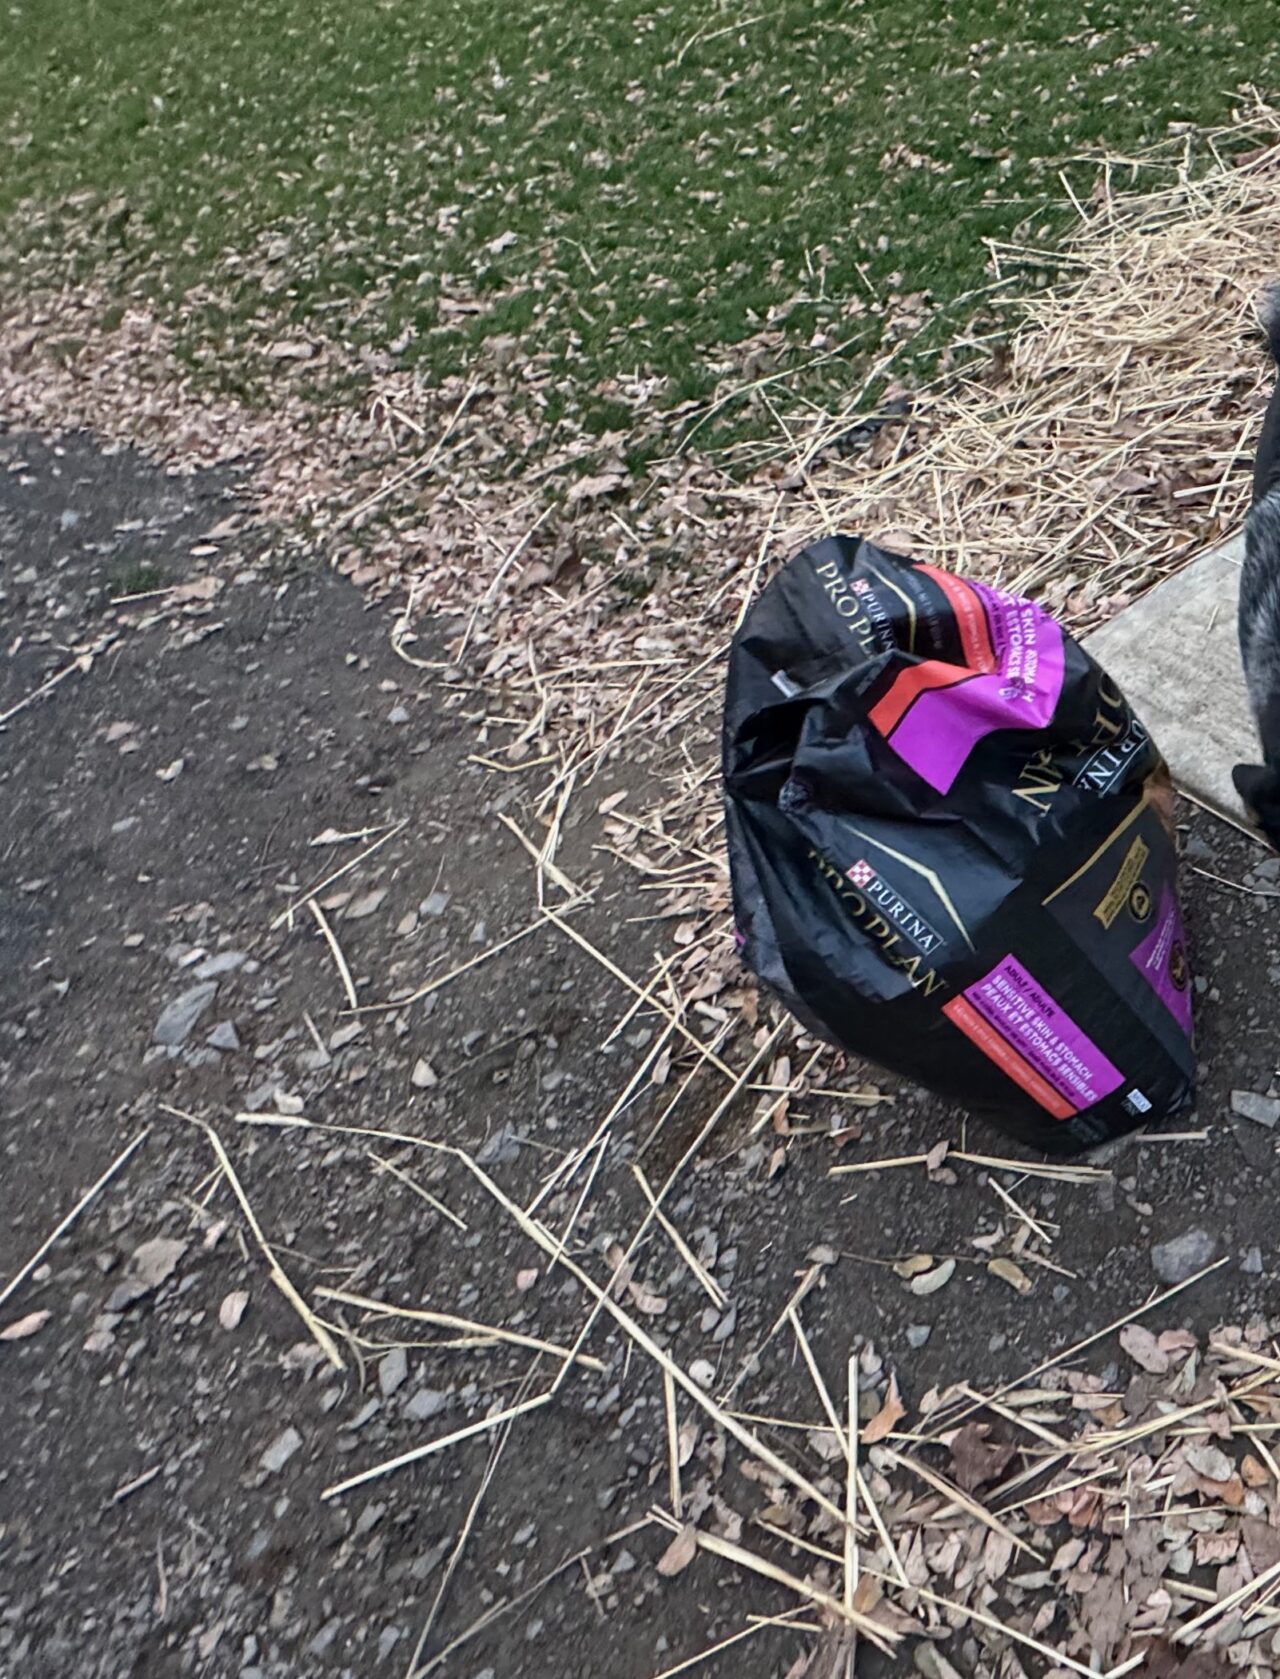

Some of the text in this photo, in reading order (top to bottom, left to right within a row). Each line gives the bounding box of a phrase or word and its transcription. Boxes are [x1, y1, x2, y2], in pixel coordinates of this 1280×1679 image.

[816, 561, 877, 661] PRO PL
[1021, 608, 1037, 646] SKIN
[867, 880, 934, 949] PURINA
[981, 983, 1013, 1014] PEAUX
[1008, 1011, 1024, 1025] ET
[1019, 1022, 1063, 1067] ESTOMACS
[1057, 1063, 1099, 1102] SENSIBLES
[992, 974, 1036, 1020] SENSITIVE
[1031, 1016, 1054, 1039] SKIN
[1054, 1042, 1094, 1081] STOMACH
